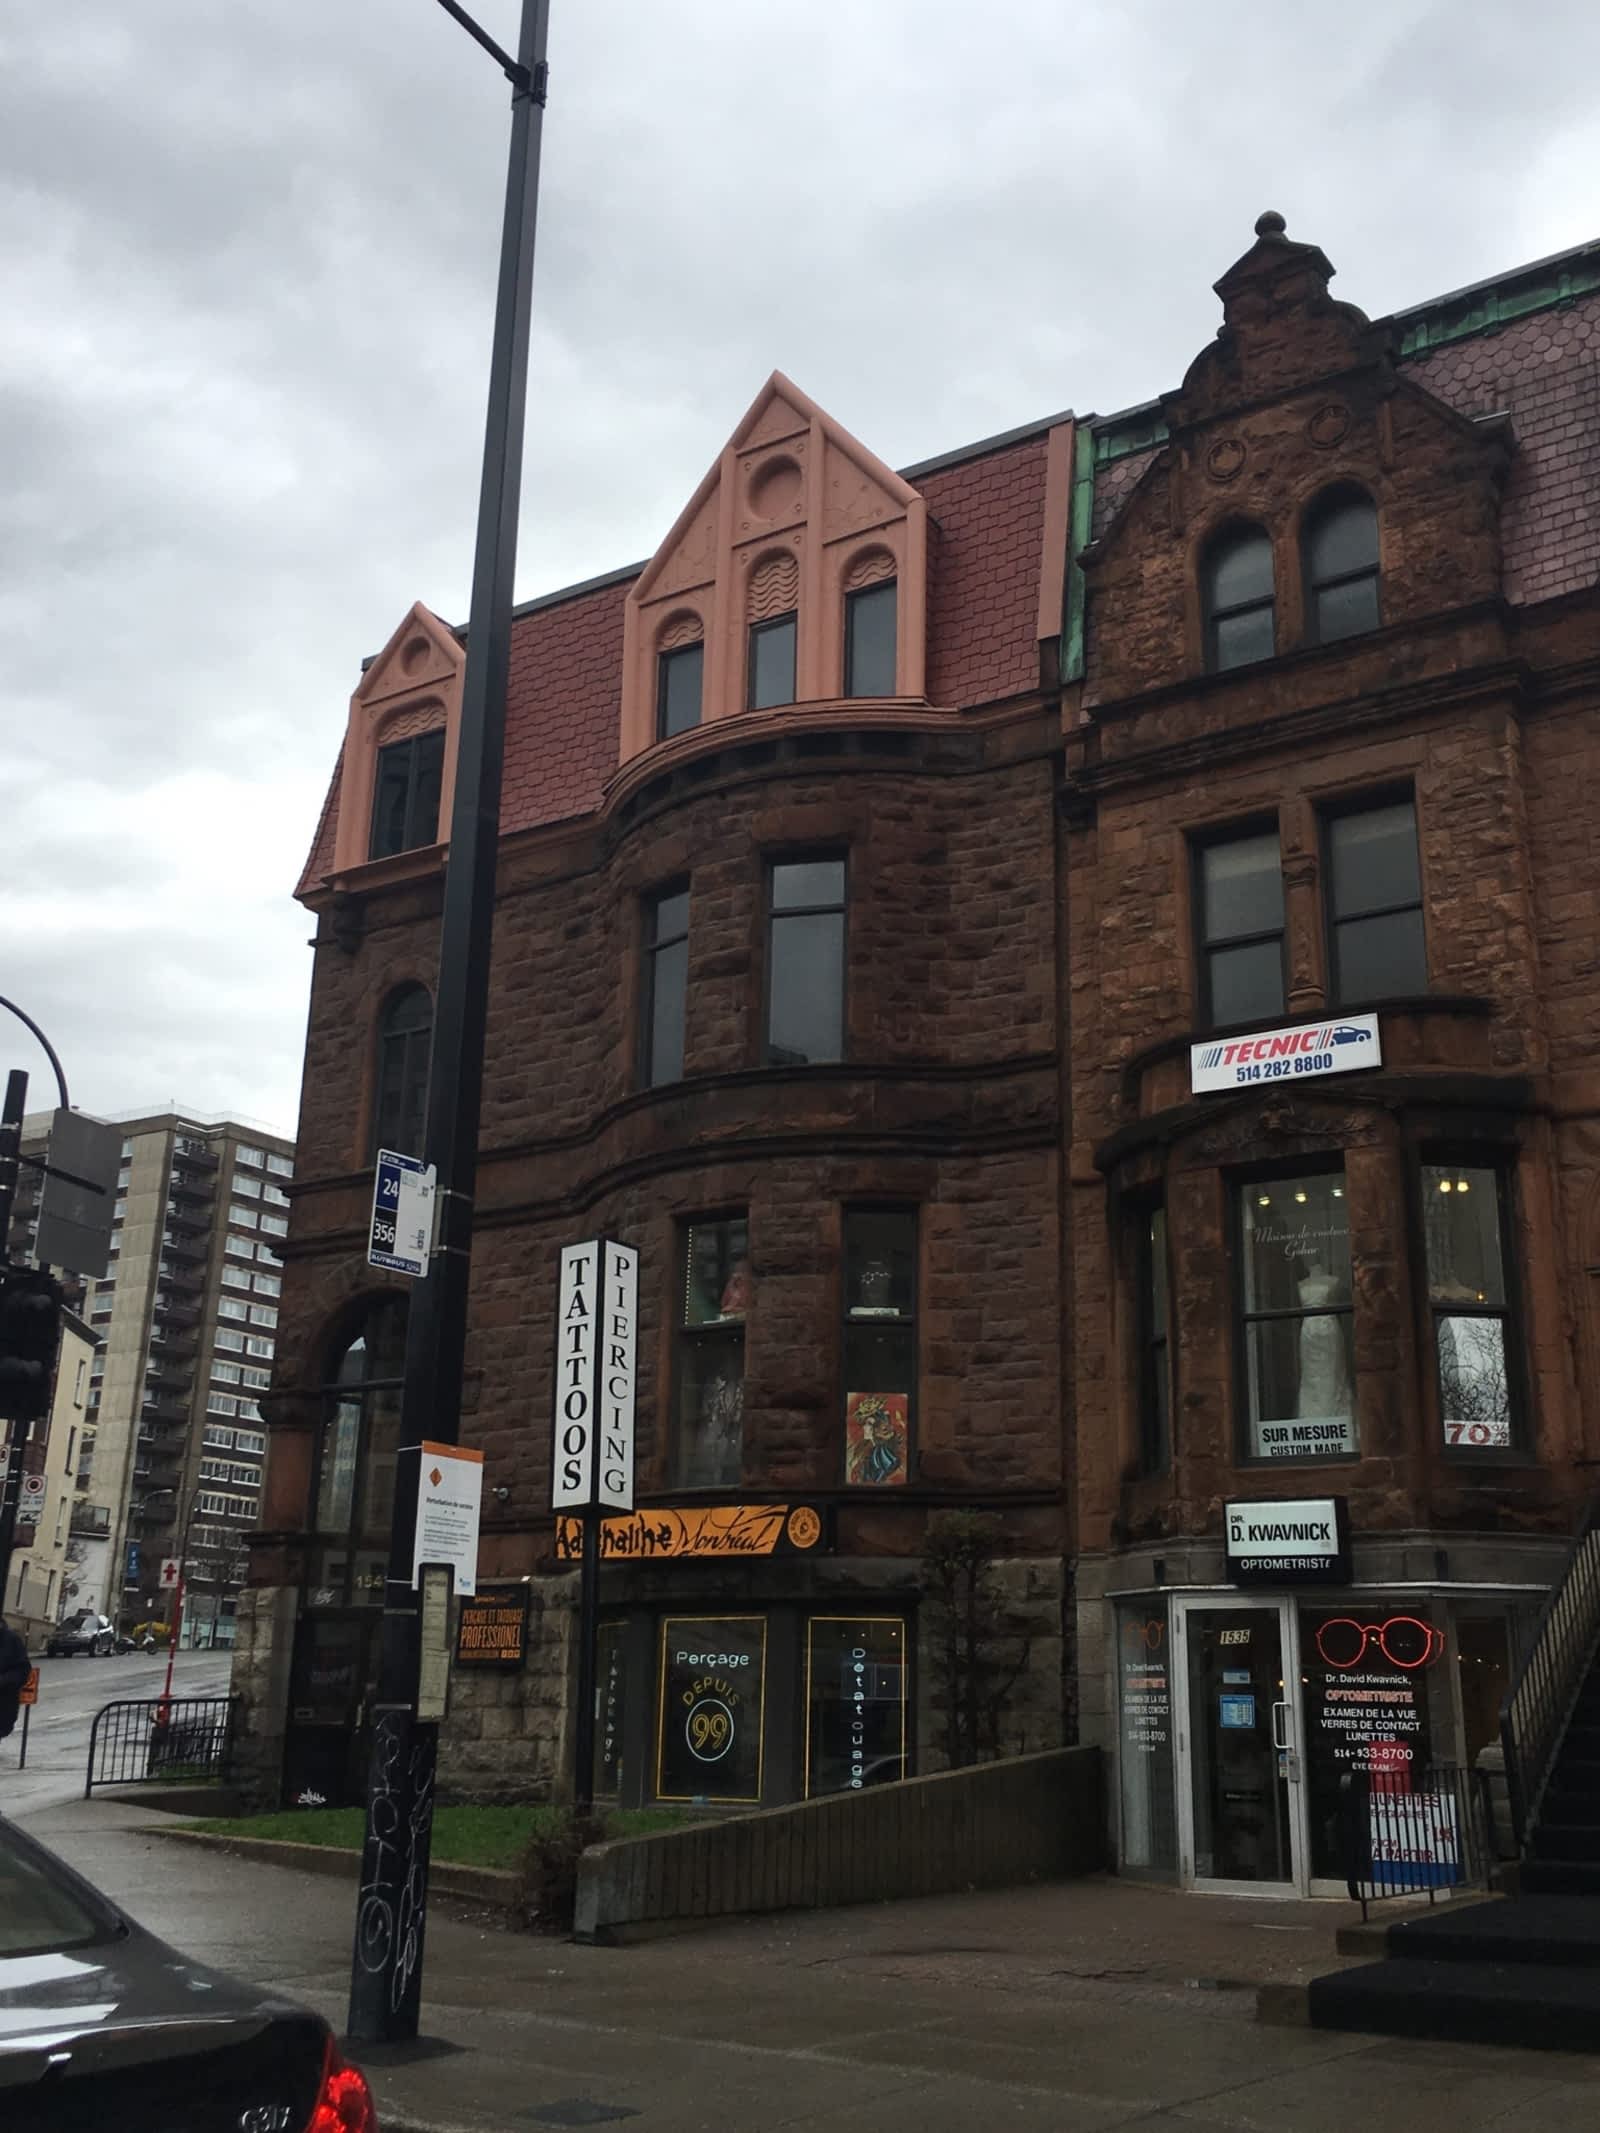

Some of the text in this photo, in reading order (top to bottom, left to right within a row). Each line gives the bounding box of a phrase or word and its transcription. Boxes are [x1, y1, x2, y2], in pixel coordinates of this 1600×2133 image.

[1223, 1030, 1319, 1065] TECNIC
[1236, 1053, 1333, 1082] 514 282 8800
[383, 1178, 399, 1198] 24
[373, 1222, 395, 1244] 356
[562, 1256, 590, 1491] TATTOOS
[604, 1254, 630, 1493] PIERCING
[1262, 1423, 1348, 1443] SUR MESURE
[1270, 1443, 1344, 1456] CUSTOM MADE
[1230, 1515, 1244, 1523] DR.
[555, 1511, 673, 1558] Adnaline
[1231, 1522, 1331, 1542] D. KWAVNICK
[1221, 1630, 1250, 1644] 1535
[676, 1651, 750, 1668] Perçage
[1325, 1674, 1412, 1685] Dr. David Kwavnick,
[682, 1676, 740, 1707] DEPUIS
[1325, 1689, 1414, 1703] OPTOMETRISTE
[1323, 1707, 1416, 1719] EXAMEN DE LA VUE
[692, 1713, 728, 1749] 99
[1320, 1719, 1421, 1731] VERRES DE CONTACT
[1345, 1731, 1396, 1742] LUNETTES
[1352, 1762, 1366, 1770] EYE
